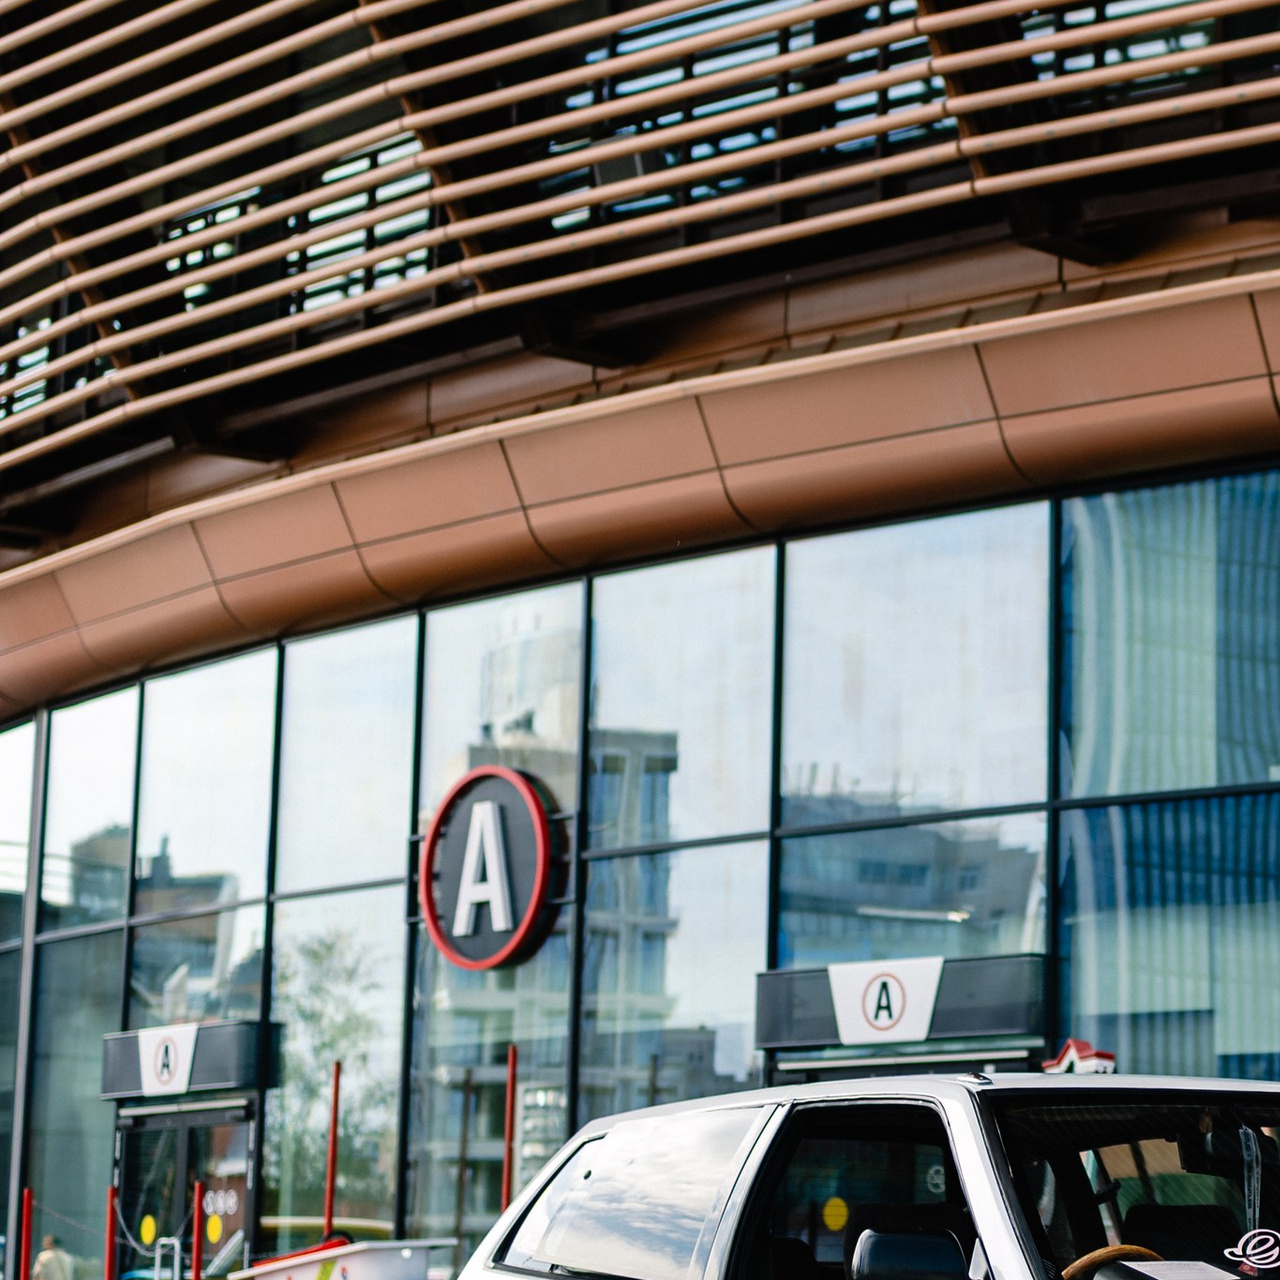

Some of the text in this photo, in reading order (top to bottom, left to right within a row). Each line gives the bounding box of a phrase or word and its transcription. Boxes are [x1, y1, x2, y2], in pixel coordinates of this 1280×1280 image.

[453, 800, 512, 937] A
[874, 980, 893, 1020] A
[160, 1044, 171, 1075] A
